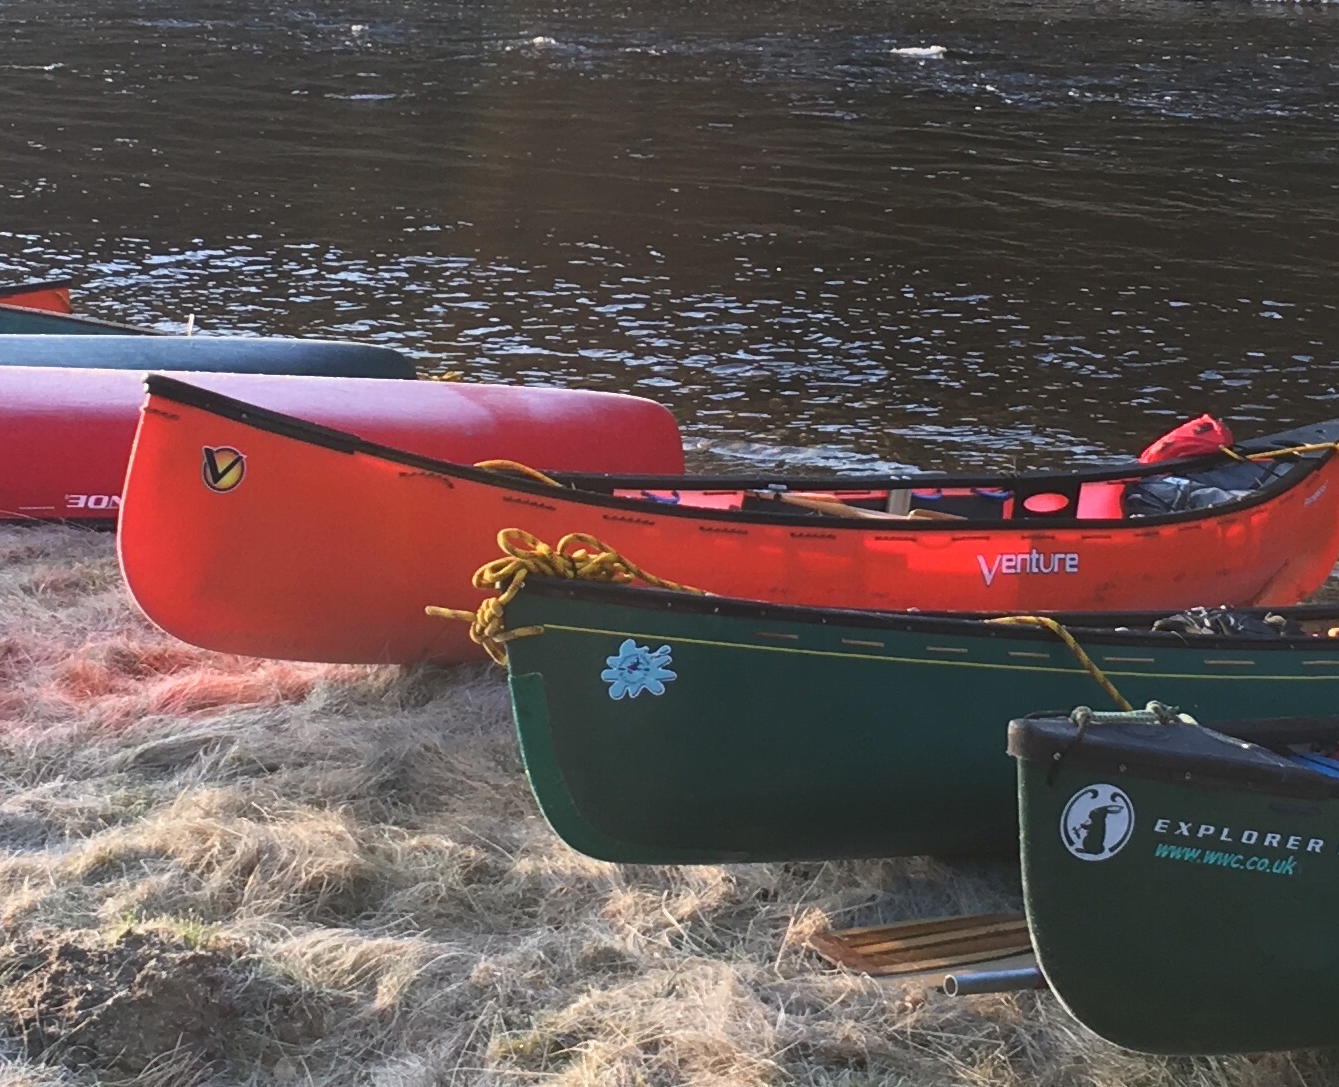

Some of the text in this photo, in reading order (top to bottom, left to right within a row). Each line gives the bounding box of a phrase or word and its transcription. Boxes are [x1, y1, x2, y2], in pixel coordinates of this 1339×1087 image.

[976, 548, 1080, 586] Venture
[1154, 818, 1325, 853] EXPLORER
[1154, 843, 1298, 876] www.wwc.co.uk
